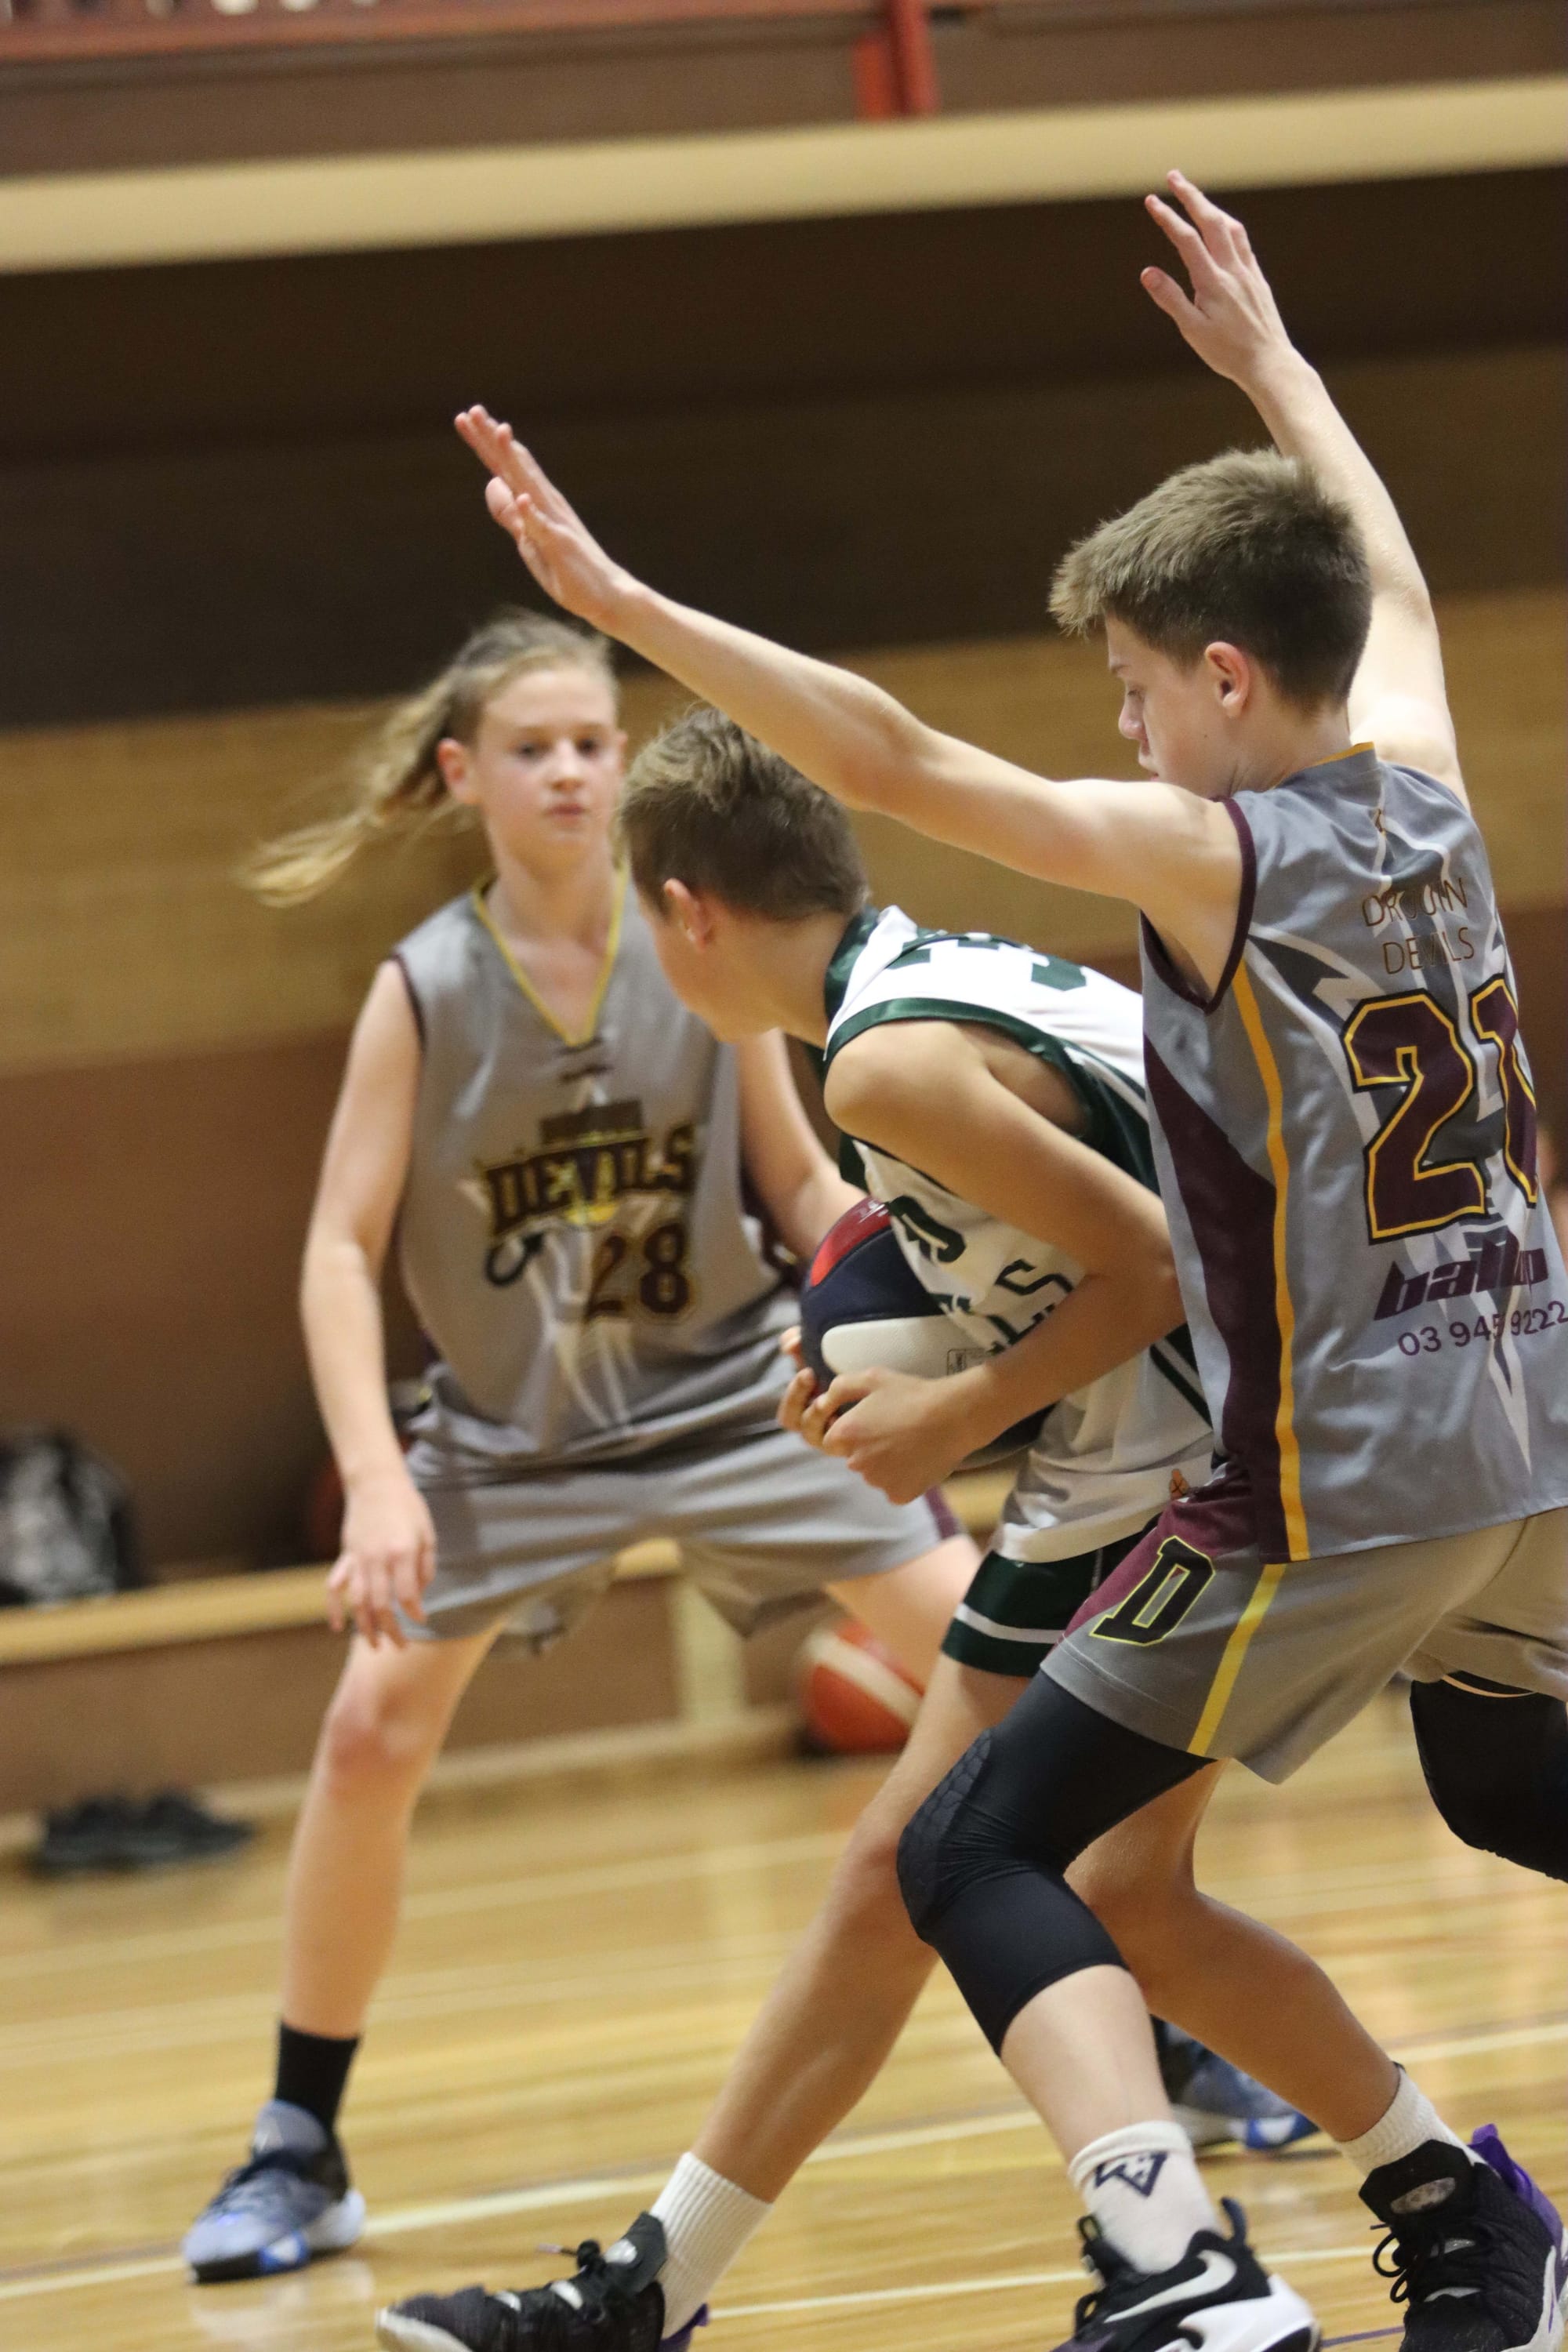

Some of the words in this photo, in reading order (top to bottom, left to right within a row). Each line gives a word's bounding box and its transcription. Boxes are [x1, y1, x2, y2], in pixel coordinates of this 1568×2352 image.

[1383, 927, 1475, 975] DEVILS
[1341, 972, 1537, 1245] 21
[583, 1220, 696, 1323] 28
[1398, 1326, 1442, 1356] 03
[1088, 1535, 1217, 1647] D
